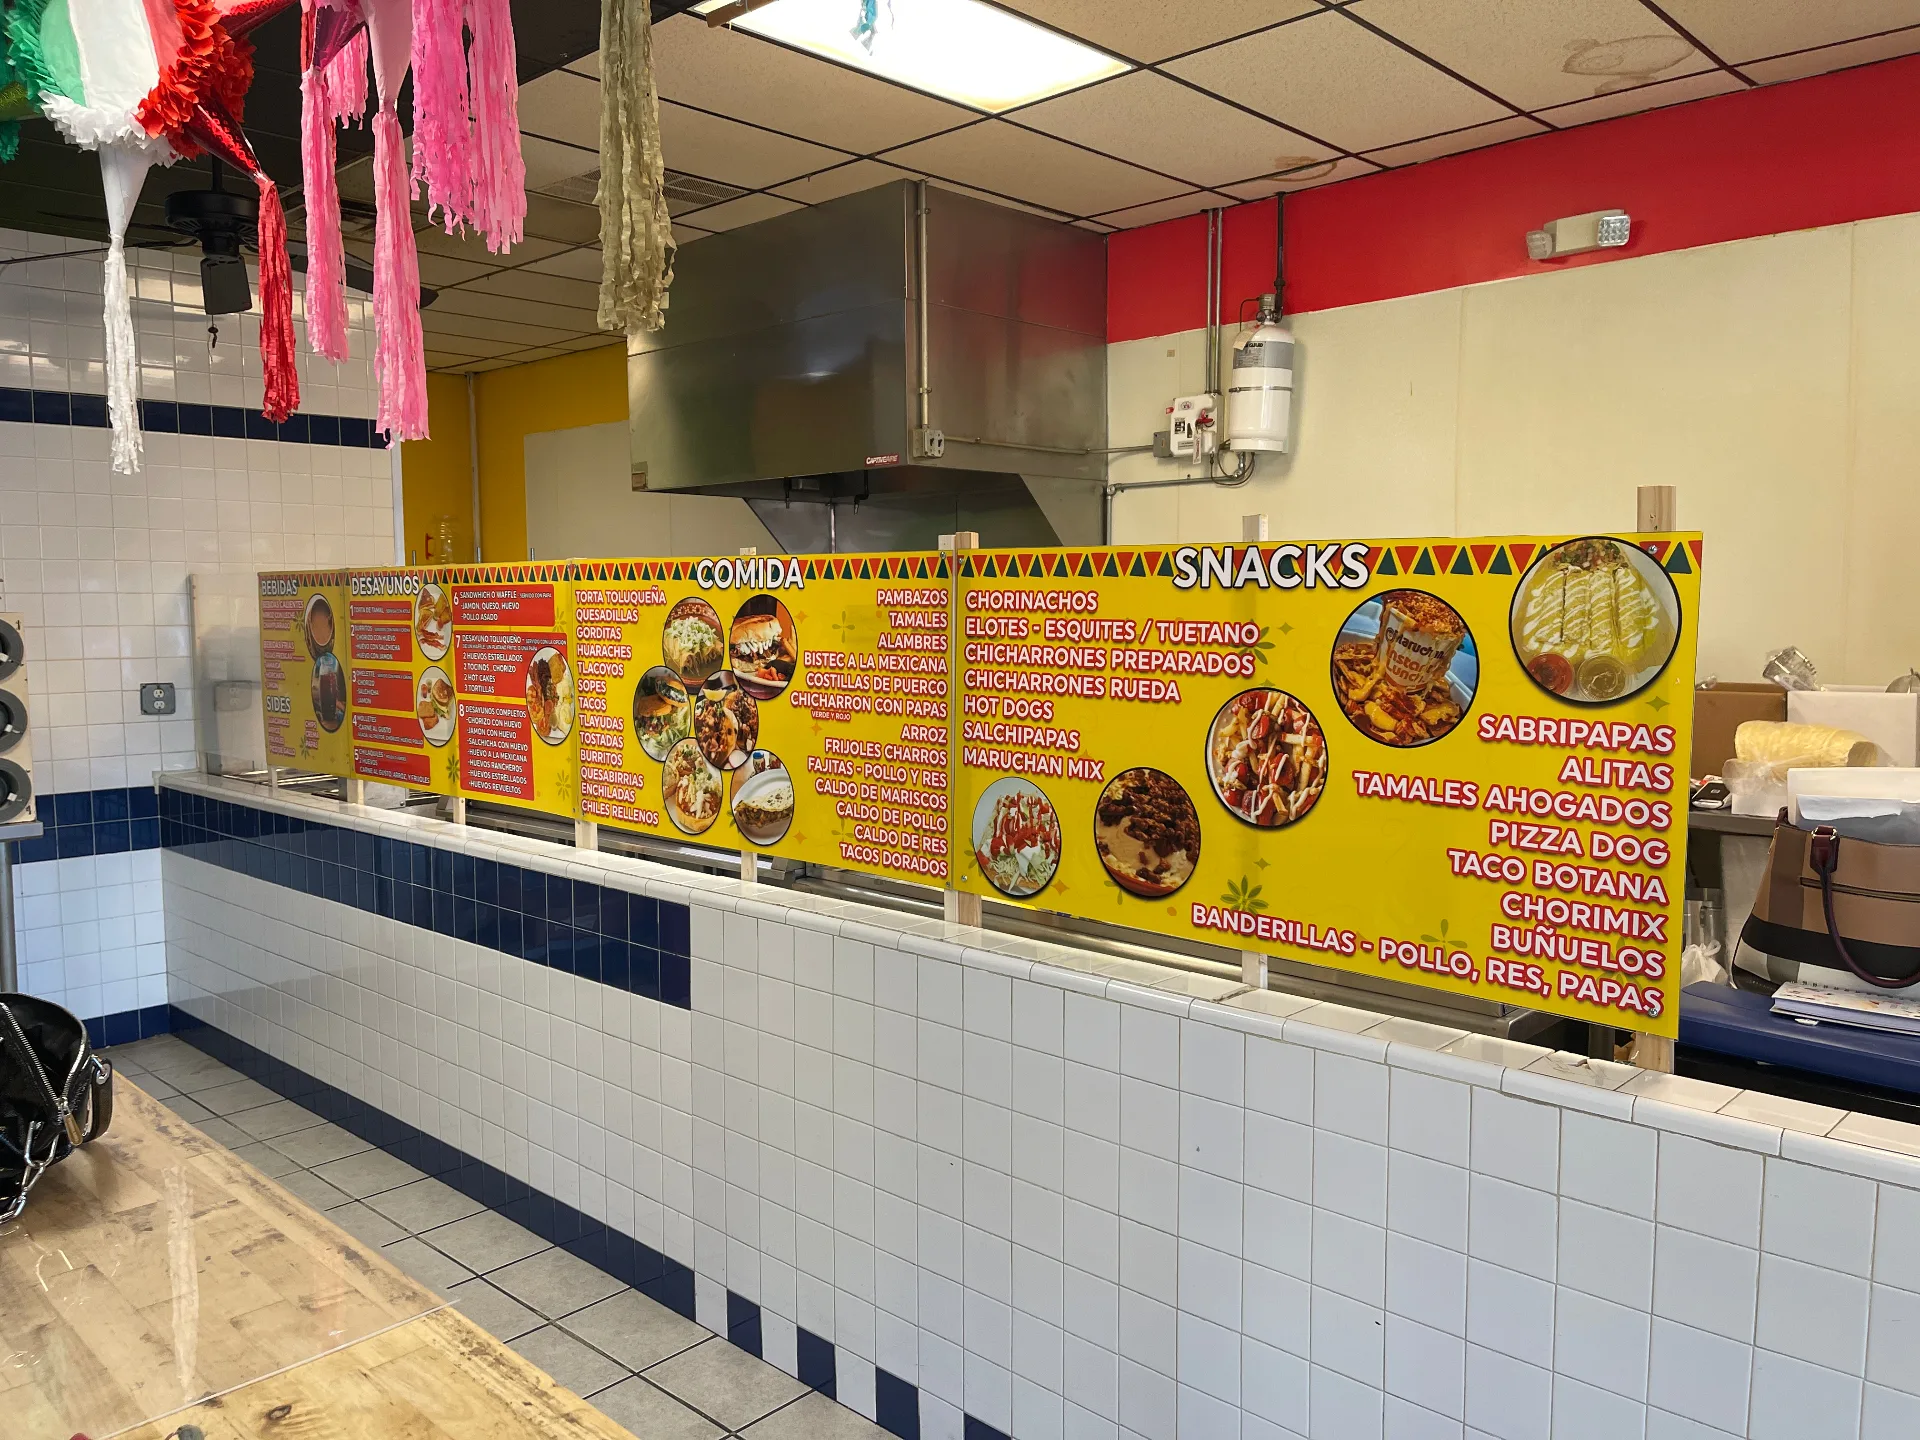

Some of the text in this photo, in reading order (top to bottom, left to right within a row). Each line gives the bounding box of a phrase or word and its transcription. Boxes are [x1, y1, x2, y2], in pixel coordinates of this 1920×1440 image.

[697, 557, 805, 589] COMIDA
[1172, 543, 1371, 589] SNACKS
[261, 579, 298, 596] BEBIDAS
[351, 576, 419, 595] DESAYUNOS
[453, 592, 459, 605] 6
[496, 590, 517, 599] WAFFLE
[575, 585, 667, 604] TORTA TOLUQUEÑA
[877, 590, 948, 605] PAMBAZOS
[965, 591, 1098, 611] CHORINACHOS
[350, 604, 354, 617] 1
[501, 602, 520, 610] HUEVO
[576, 609, 639, 622] QUESADILLAS
[889, 611, 948, 628] TAMALES
[350, 624, 355, 636] 2
[576, 626, 622, 640] GORDITAS
[965, 617, 1028, 638] ELOTES
[1044, 620, 1136, 642] ESQUITES
[1156, 621, 1259, 645] TUETANO
[455, 635, 460, 648] 7
[462, 634, 489, 643] DESAYUNO
[878, 633, 948, 650] ALAMBRES
[463, 652, 523, 662] 2 HUEVOS ESTRELLADOS
[577, 644, 632, 658] HUARACHES
[492, 664, 517, 673] CHORIZO
[577, 661, 624, 676] TLACOYOS
[804, 651, 948, 673] BISTEC A LA MEXICANA
[964, 644, 1255, 676] CHICHARRONES PREPARADOS
[352, 670, 357, 683] 3
[479, 675, 496, 683] CAKES
[806, 672, 947, 695] COSTILLAS DE PUERCO
[468, 684, 494, 693] TORTILLAS
[578, 680, 606, 692] SOPES
[964, 670, 1182, 701] CHICHARRONES RUEDA
[266, 695, 291, 713] SIDES
[459, 704, 526, 718] 8 DESAYUNOS COMPLETOS
[578, 697, 607, 710] TACOS
[791, 691, 948, 718] CHICHARRON CON PAPAS
[964, 695, 1053, 719] HOT DOGS
[352, 714, 357, 727] 4
[579, 714, 624, 731] TLAYUDAS
[811, 710, 830, 719] VERDE
[491, 718, 503, 727] CON
[503, 720, 521, 729] HUEVO
[486, 728, 498, 737] CON
[498, 730, 517, 739] HUEVO
[580, 731, 624, 748] TOSTADAS
[901, 725, 947, 743] ARROZ
[963, 721, 1080, 749] SALCHIPAPAS
[1479, 715, 1675, 753] SABRIPAPAS
[354, 748, 359, 761] 5
[497, 740, 509, 749] CON
[510, 742, 528, 752] HUEVO
[825, 738, 948, 766] FRIJOLES CHARROS
[492, 751, 500, 759] LA
[500, 752, 528, 762] MEXICANA
[580, 749, 623, 766] BURRITOS
[963, 746, 1104, 780] MARUCHAN MIX
[491, 761, 523, 772] RANCHEROS
[808, 757, 854, 774] FAJITAS
[864, 763, 907, 782] POLLO
[910, 769, 919, 784] Y
[922, 771, 947, 788] RES
[1559, 757, 1674, 790] ALITAS
[491, 772, 527, 785] ESTRELLADOS
[581, 767, 644, 787] QUESABIRRIAS
[492, 783, 521, 795] REVUELTOS
[581, 782, 635, 802] ENCHILADAS
[815, 778, 947, 810] CALDO DE MARISCOS
[1353, 771, 1672, 829] TAMALES AHOGADOS
[581, 799, 659, 825] CHILES RELLENOS
[836, 802, 947, 832] CALDO DE POLLO
[854, 825, 947, 854] CALDO DE RES
[1490, 821, 1670, 866] PIZZA DOG
[840, 843, 948, 877] TACOS DORADOS
[1447, 850, 1669, 904] TACO BOTANA
[1501, 893, 1667, 941] CHORIMIX
[1191, 903, 1356, 954] BANDERILLAS
[1380, 937, 1479, 981] POLLO,
[1486, 958, 1552, 997] RES,
[1558, 971, 1664, 1016] PAPAS
[1491, 924, 1665, 978] BUÑUELOS
